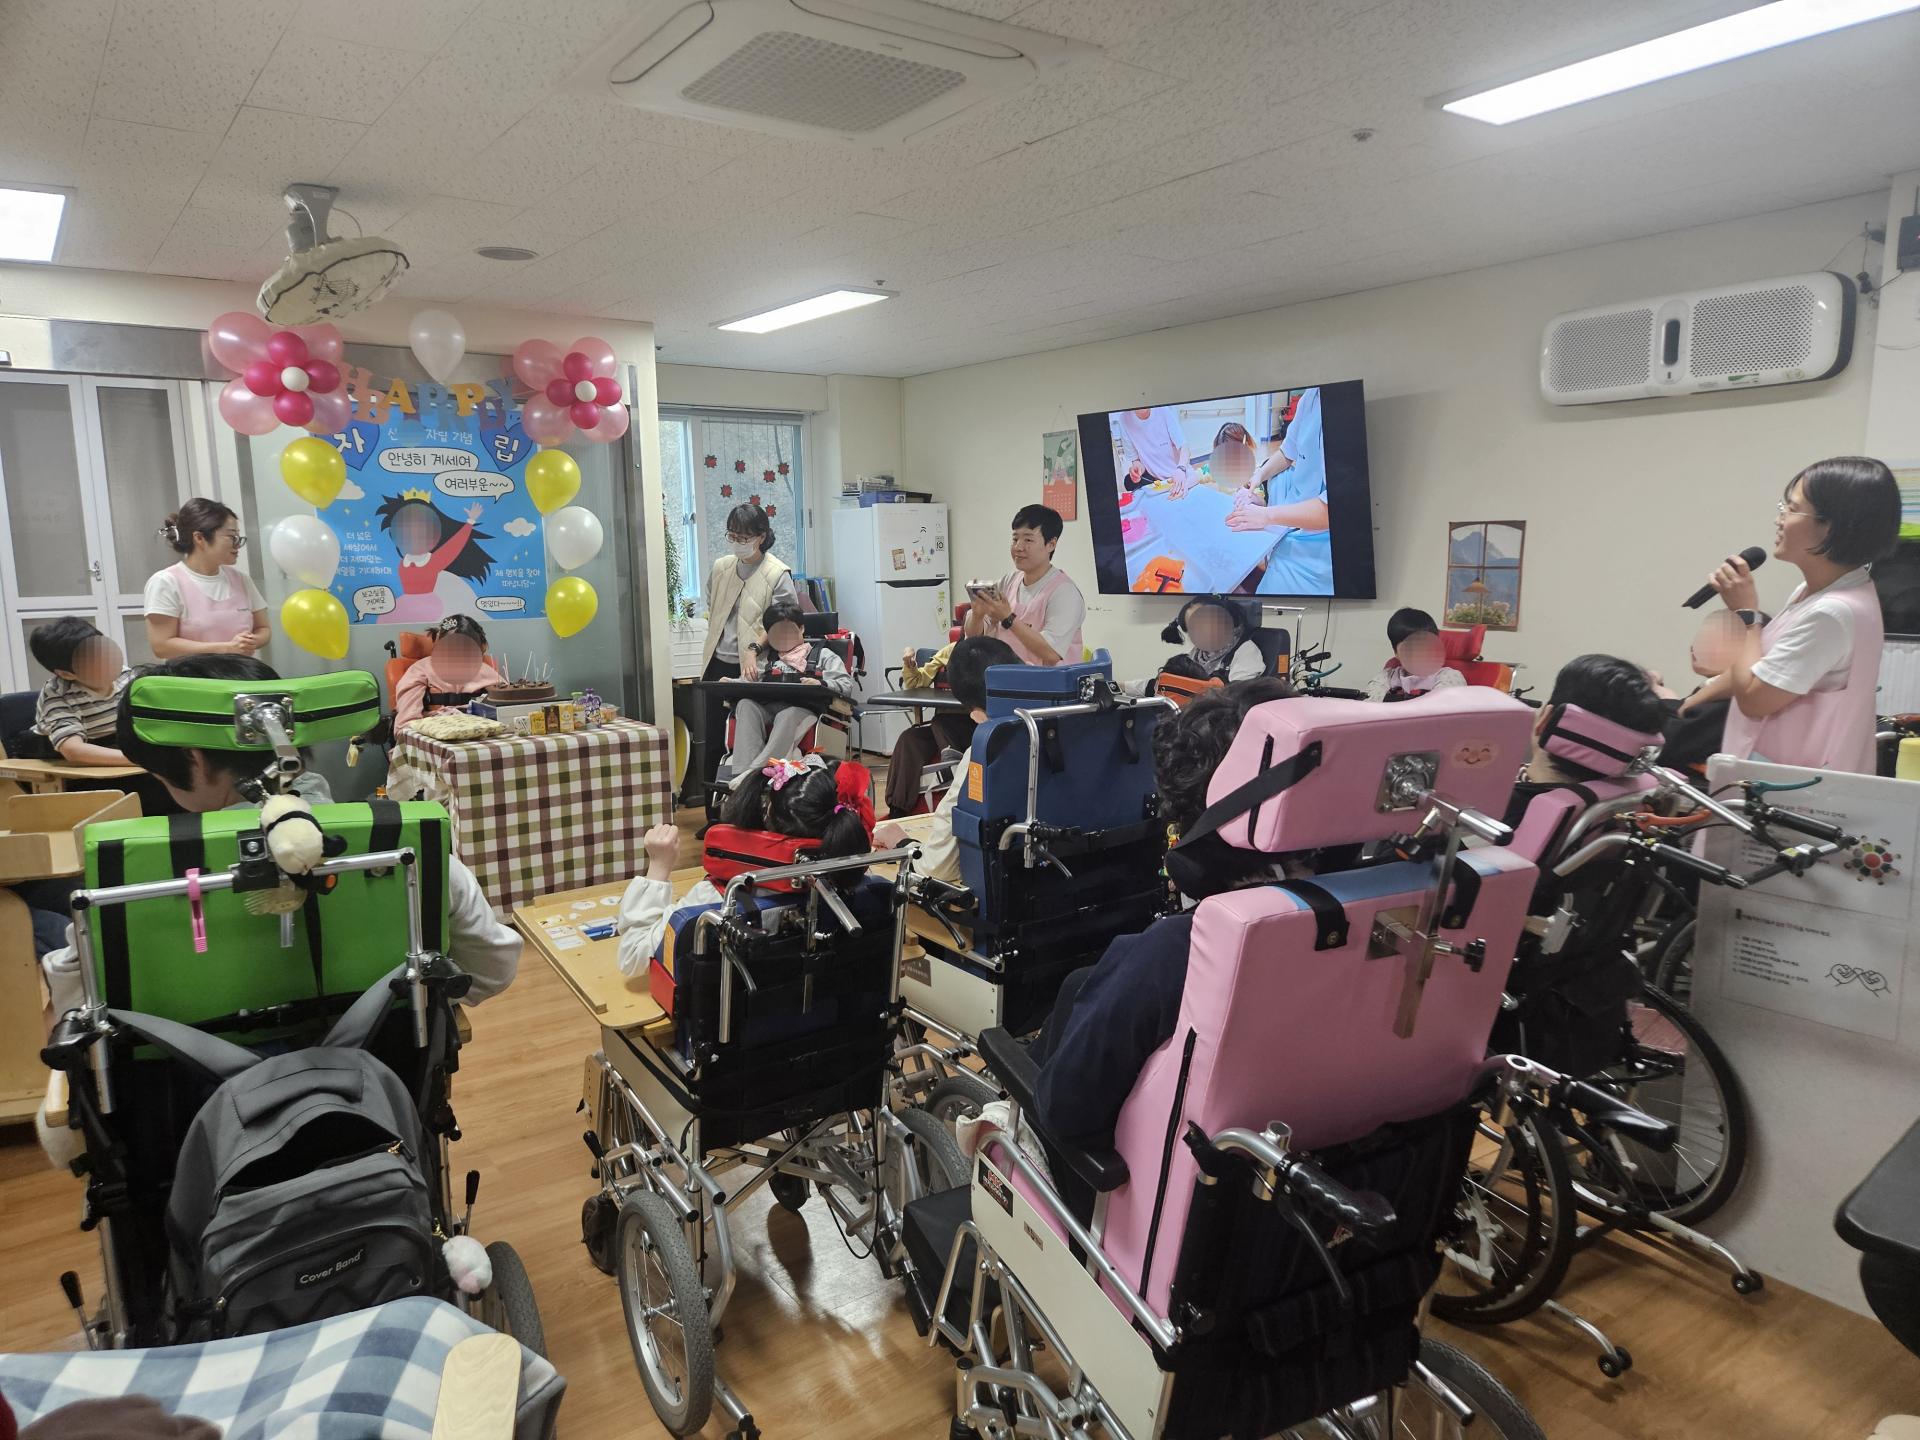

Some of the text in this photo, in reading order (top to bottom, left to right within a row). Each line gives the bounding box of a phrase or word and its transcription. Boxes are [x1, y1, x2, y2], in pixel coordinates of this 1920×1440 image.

[338, 361, 518, 418] HAPPY
[333, 427, 366, 454] 자
[452, 431, 474, 446] 기념
[494, 433, 520, 463] 립
[387, 451, 472, 468] 안녕히 계세여
[444, 477, 509, 492] 여러부운~~
[346, 531, 355, 541] 더
[343, 543, 378, 552] 세상에서
[526, 567, 541, 578] 찾아
[299, 1248, 364, 1284] Cover Band
